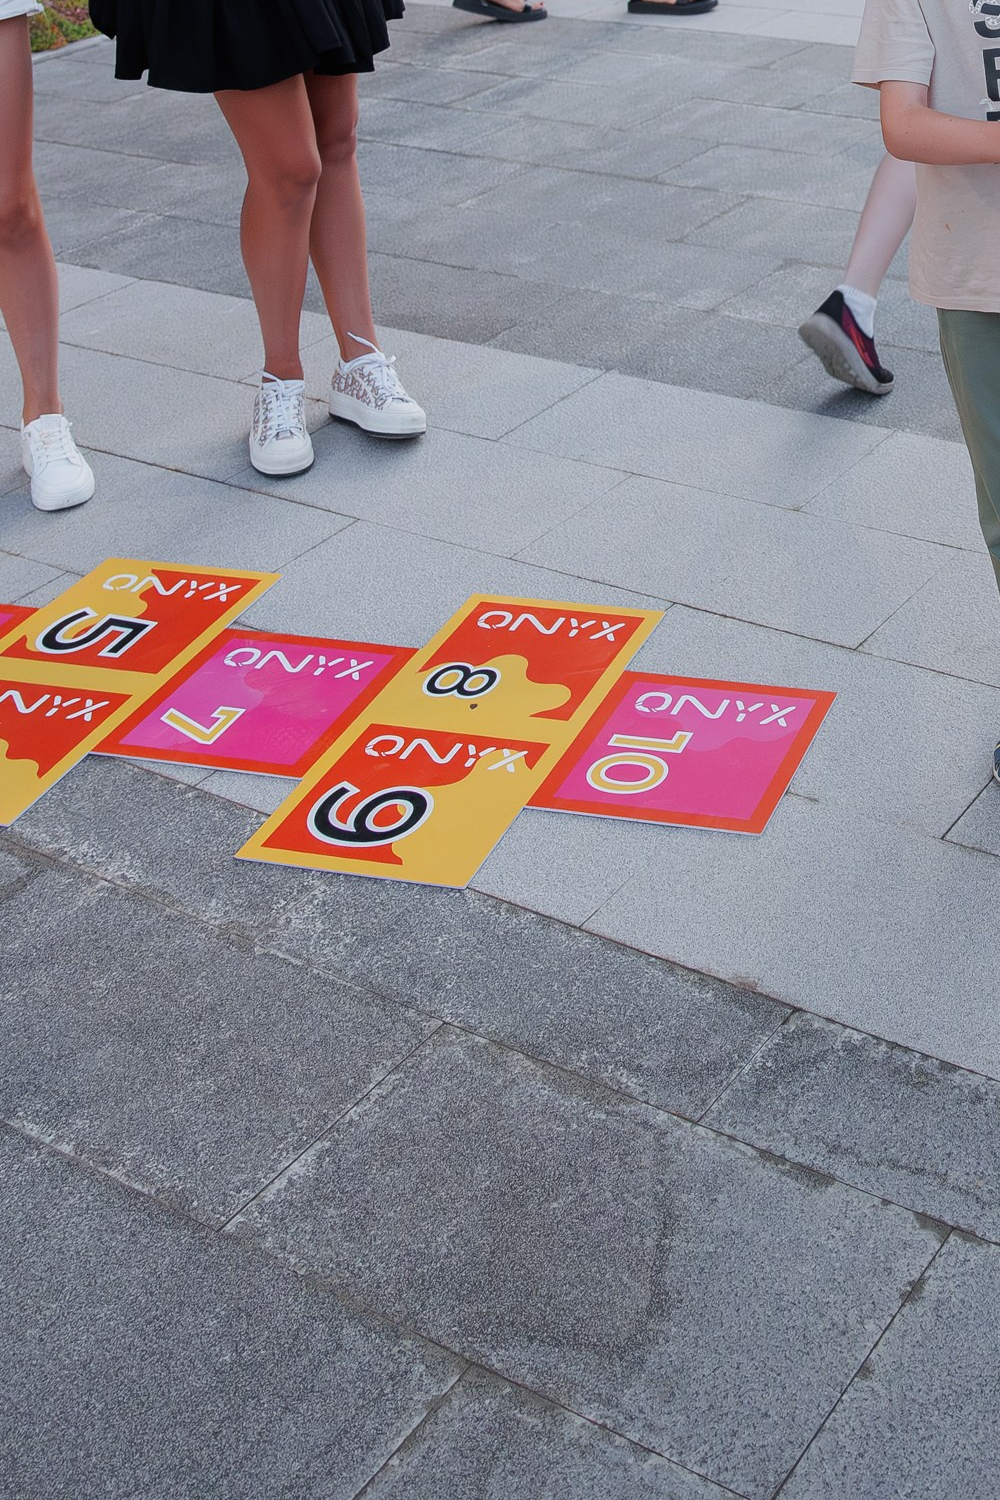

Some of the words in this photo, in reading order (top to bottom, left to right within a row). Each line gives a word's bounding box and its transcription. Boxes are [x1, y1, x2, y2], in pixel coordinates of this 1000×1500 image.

[102, 573, 242, 602] ONYX
[35, 606, 158, 658] 5
[476, 609, 626, 642] ONYX
[224, 647, 374, 681] ONYX
[421, 661, 502, 700] 8
[0, 689, 110, 722] NYX
[634, 691, 797, 728] ONYX
[159, 705, 247, 746] 7
[364, 734, 529, 773] ONYX
[586, 730, 695, 795] 10
